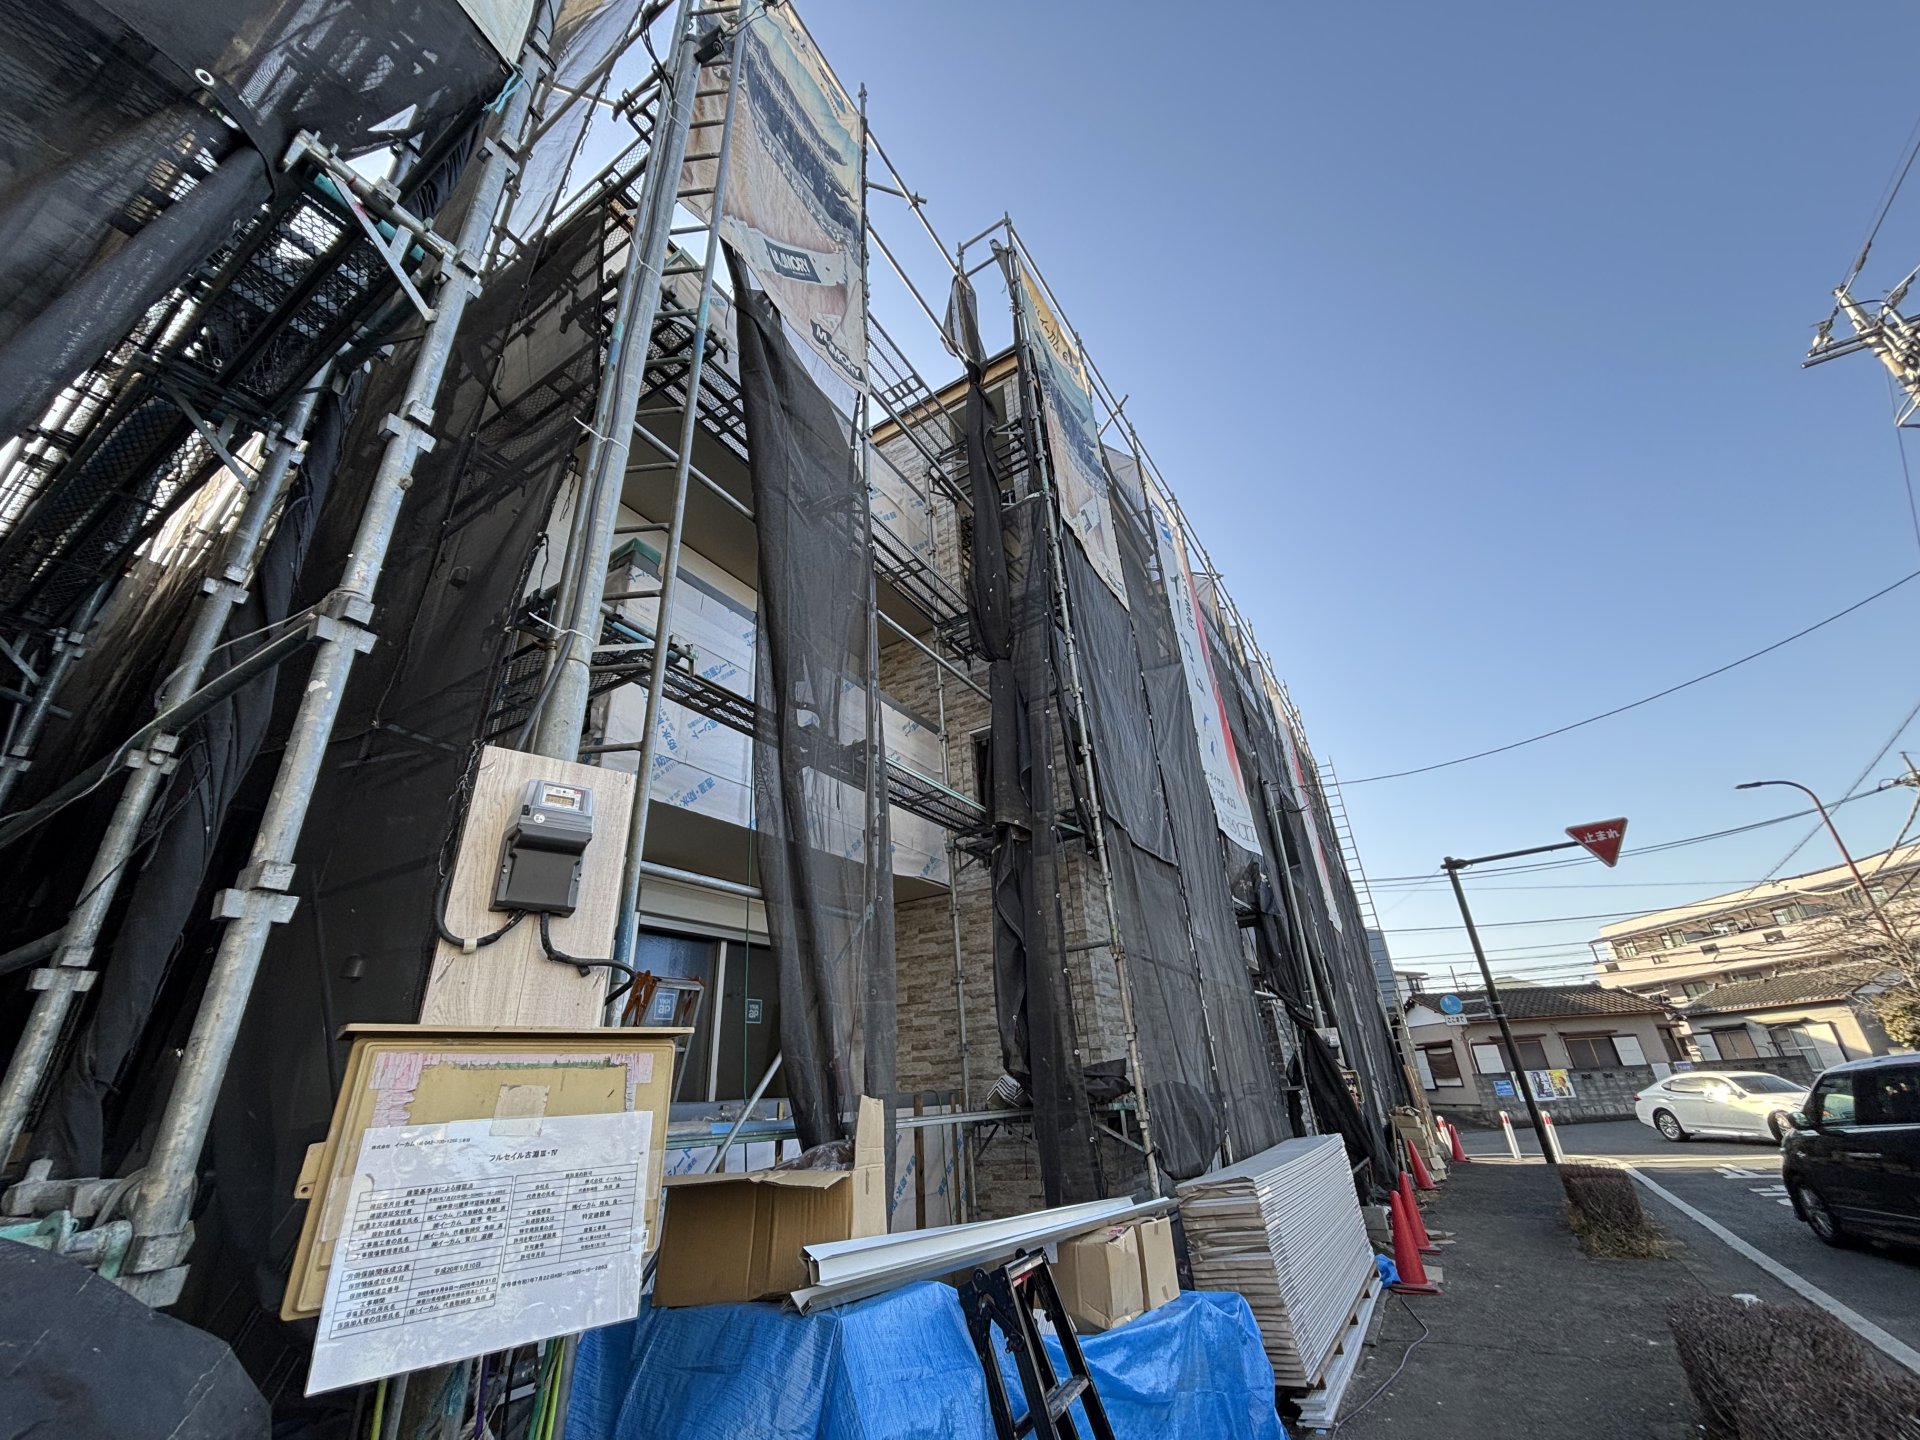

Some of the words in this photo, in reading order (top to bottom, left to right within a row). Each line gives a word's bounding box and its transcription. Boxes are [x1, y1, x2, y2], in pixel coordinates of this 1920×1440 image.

[1584, 828, 1621, 843] 止まれ
[658, 1004, 671, 1015] ap
[748, 1009, 759, 1018] ap
